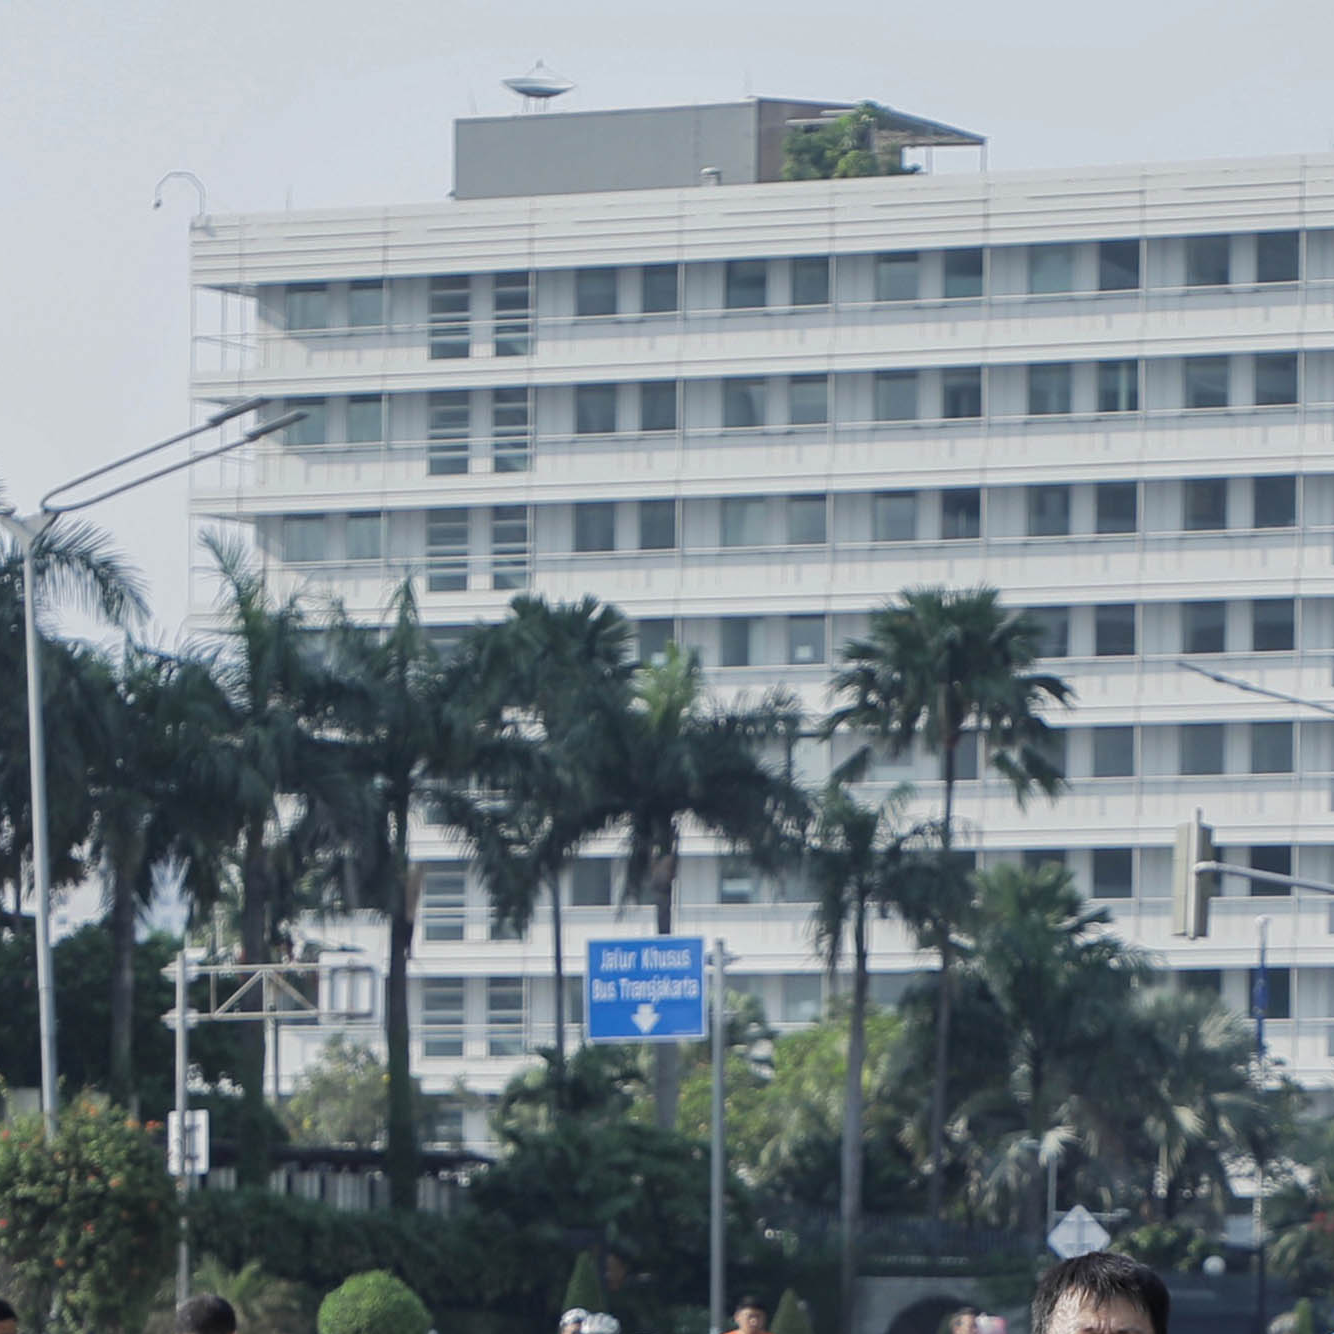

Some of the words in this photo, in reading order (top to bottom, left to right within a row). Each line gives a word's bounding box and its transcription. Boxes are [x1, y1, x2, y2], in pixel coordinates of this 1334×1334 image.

[600, 948, 637, 971] Jalur
[641, 946, 691, 969] Khusus
[592, 977, 617, 1001] Bus
[619, 973, 699, 1004] Transjakarta
